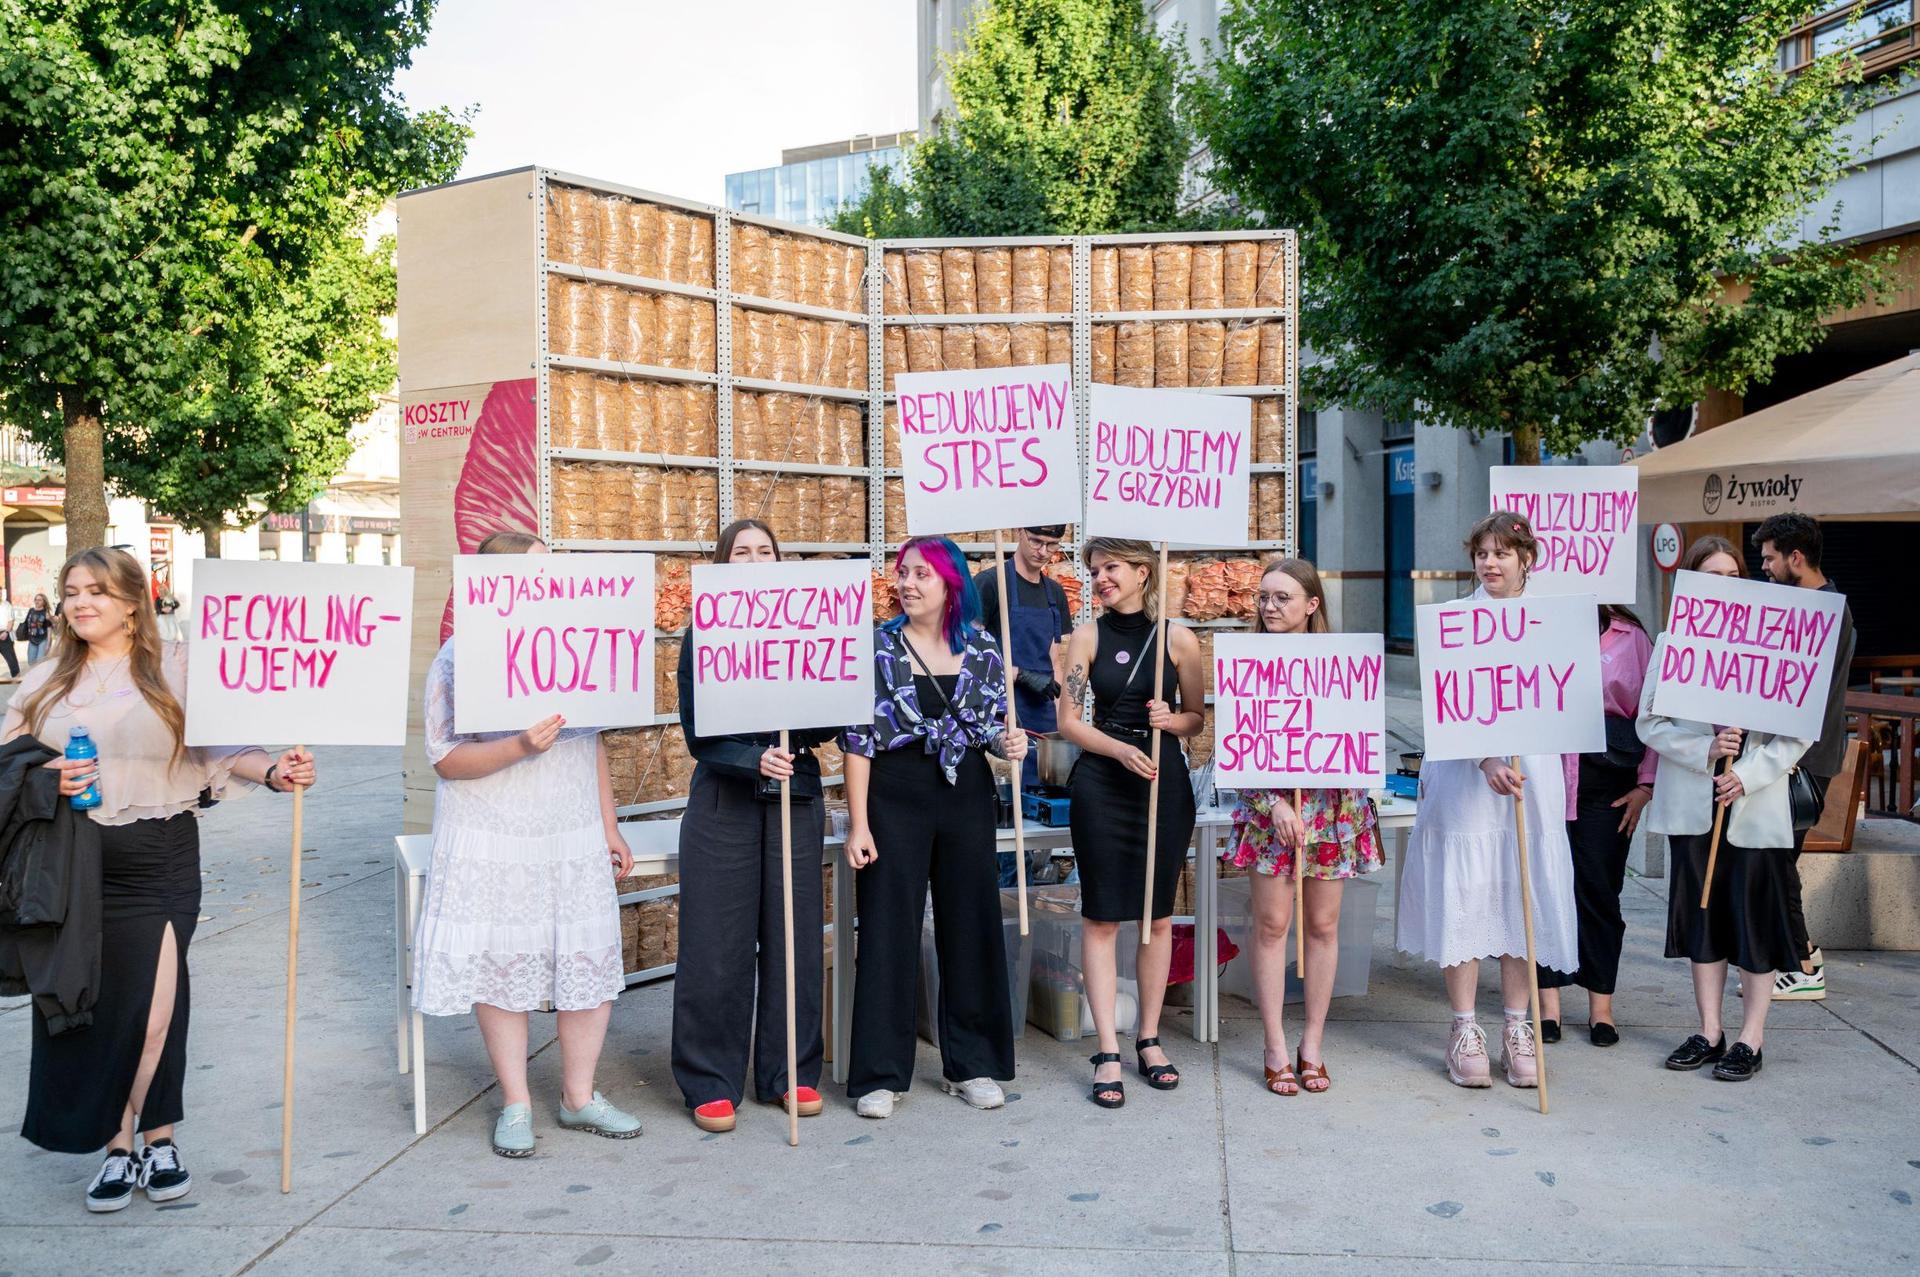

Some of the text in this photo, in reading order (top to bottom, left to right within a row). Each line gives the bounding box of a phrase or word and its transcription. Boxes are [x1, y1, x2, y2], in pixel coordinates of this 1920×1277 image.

[405, 400, 470, 425] KOSZTY
[431, 425, 472, 438] CENTRUM
[900, 380, 1068, 435] REDUKUJEMY
[919, 436, 1049, 493] STRES
[1096, 421, 1242, 476] BUDUJEMY
[1092, 468, 1221, 509] Z GRZYBNI
[1726, 474, 1803, 505] Żywioły
[1532, 535, 1614, 576] DPADY
[1657, 538, 1676, 552] LPG
[468, 567, 635, 617] WYJAŚNIAMY
[695, 580, 867, 631] OCZYSZCZAMY
[201, 594, 401, 647] RECYKLING-
[1439, 606, 1542, 649] EDU-
[219, 645, 338, 694] UJEMY
[506, 626, 646, 698] KOSZTY
[697, 637, 860, 684] POWIETRZE
[1217, 654, 1382, 702] WZMACNIAMY
[1661, 644, 1819, 708] DO NATURY
[1434, 662, 1576, 726] KUJEMY
[1218, 731, 1381, 775] SPOŁECZNE
